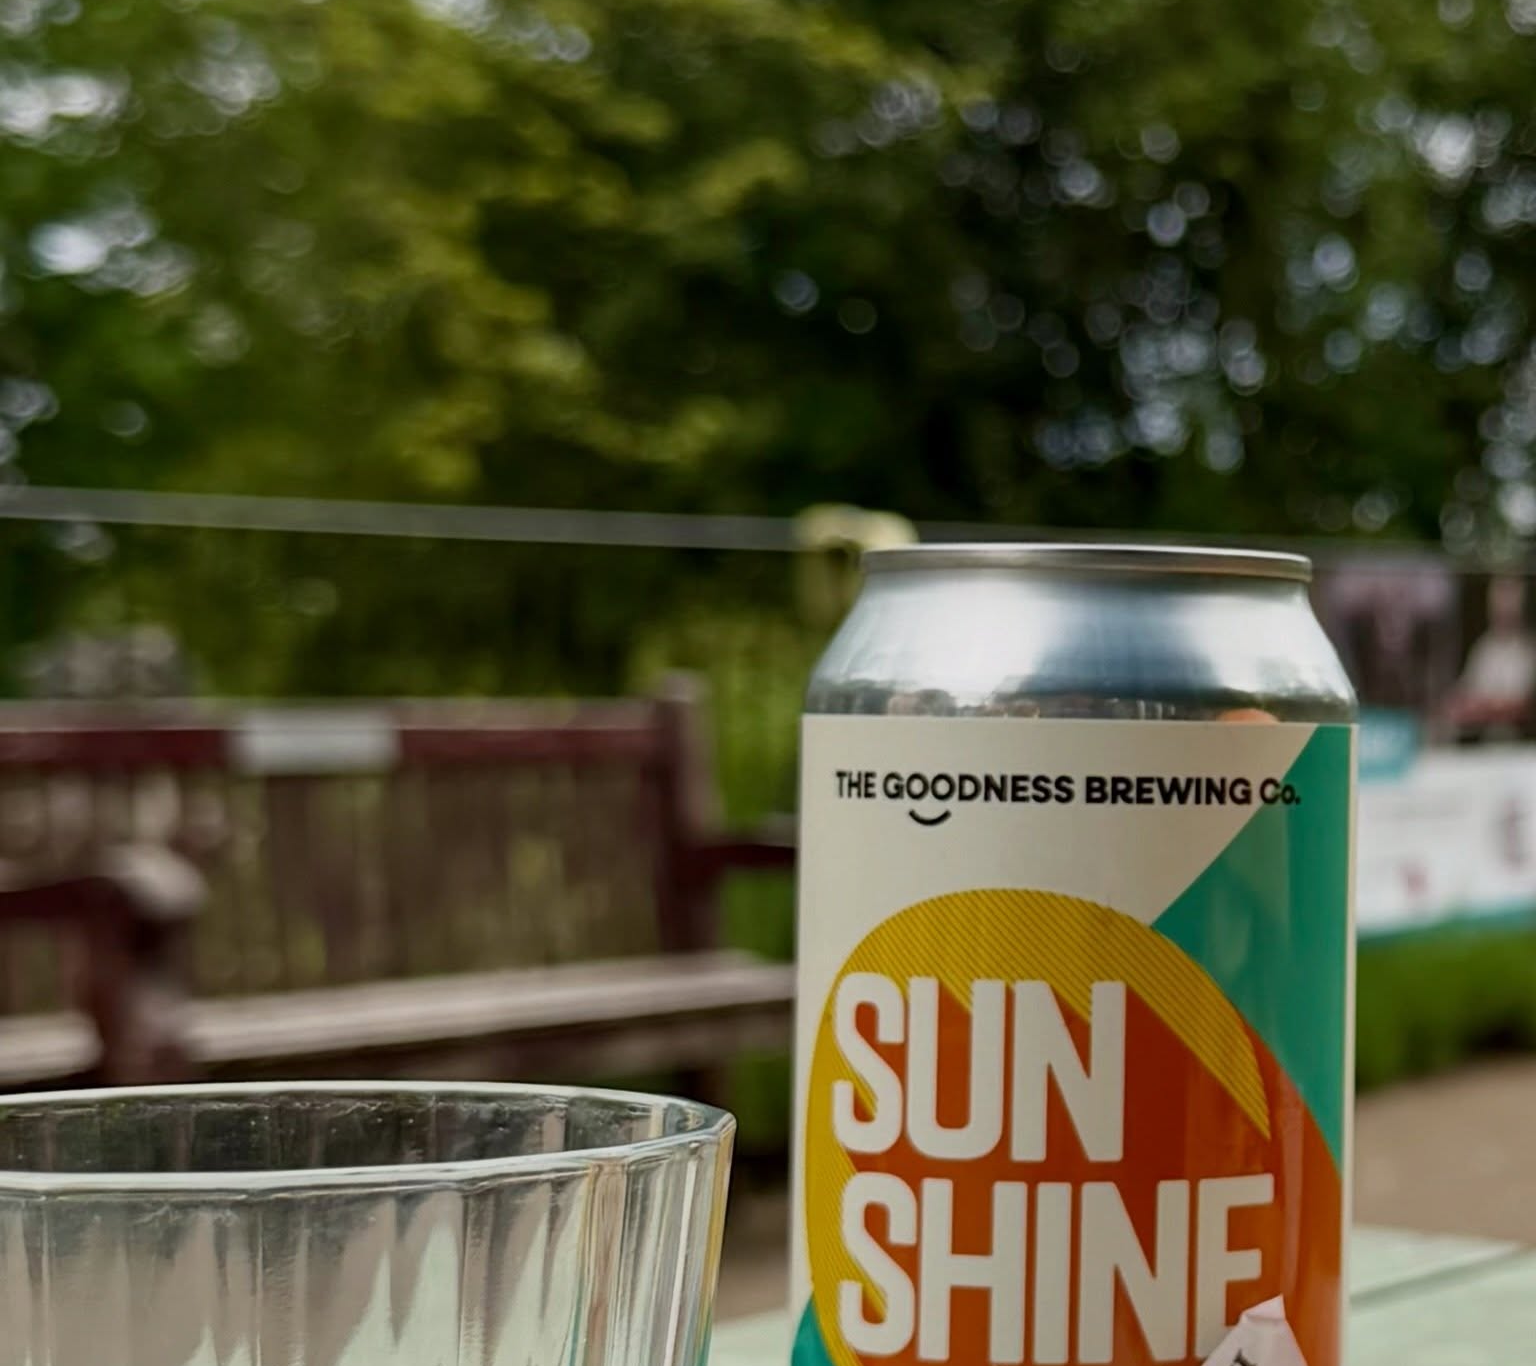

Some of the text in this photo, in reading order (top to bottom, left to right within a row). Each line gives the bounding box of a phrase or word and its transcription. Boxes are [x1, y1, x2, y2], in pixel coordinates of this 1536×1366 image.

[835, 769, 1302, 806] THE GOODNESS BREWING Co.
[830, 971, 1127, 1162] SUN
